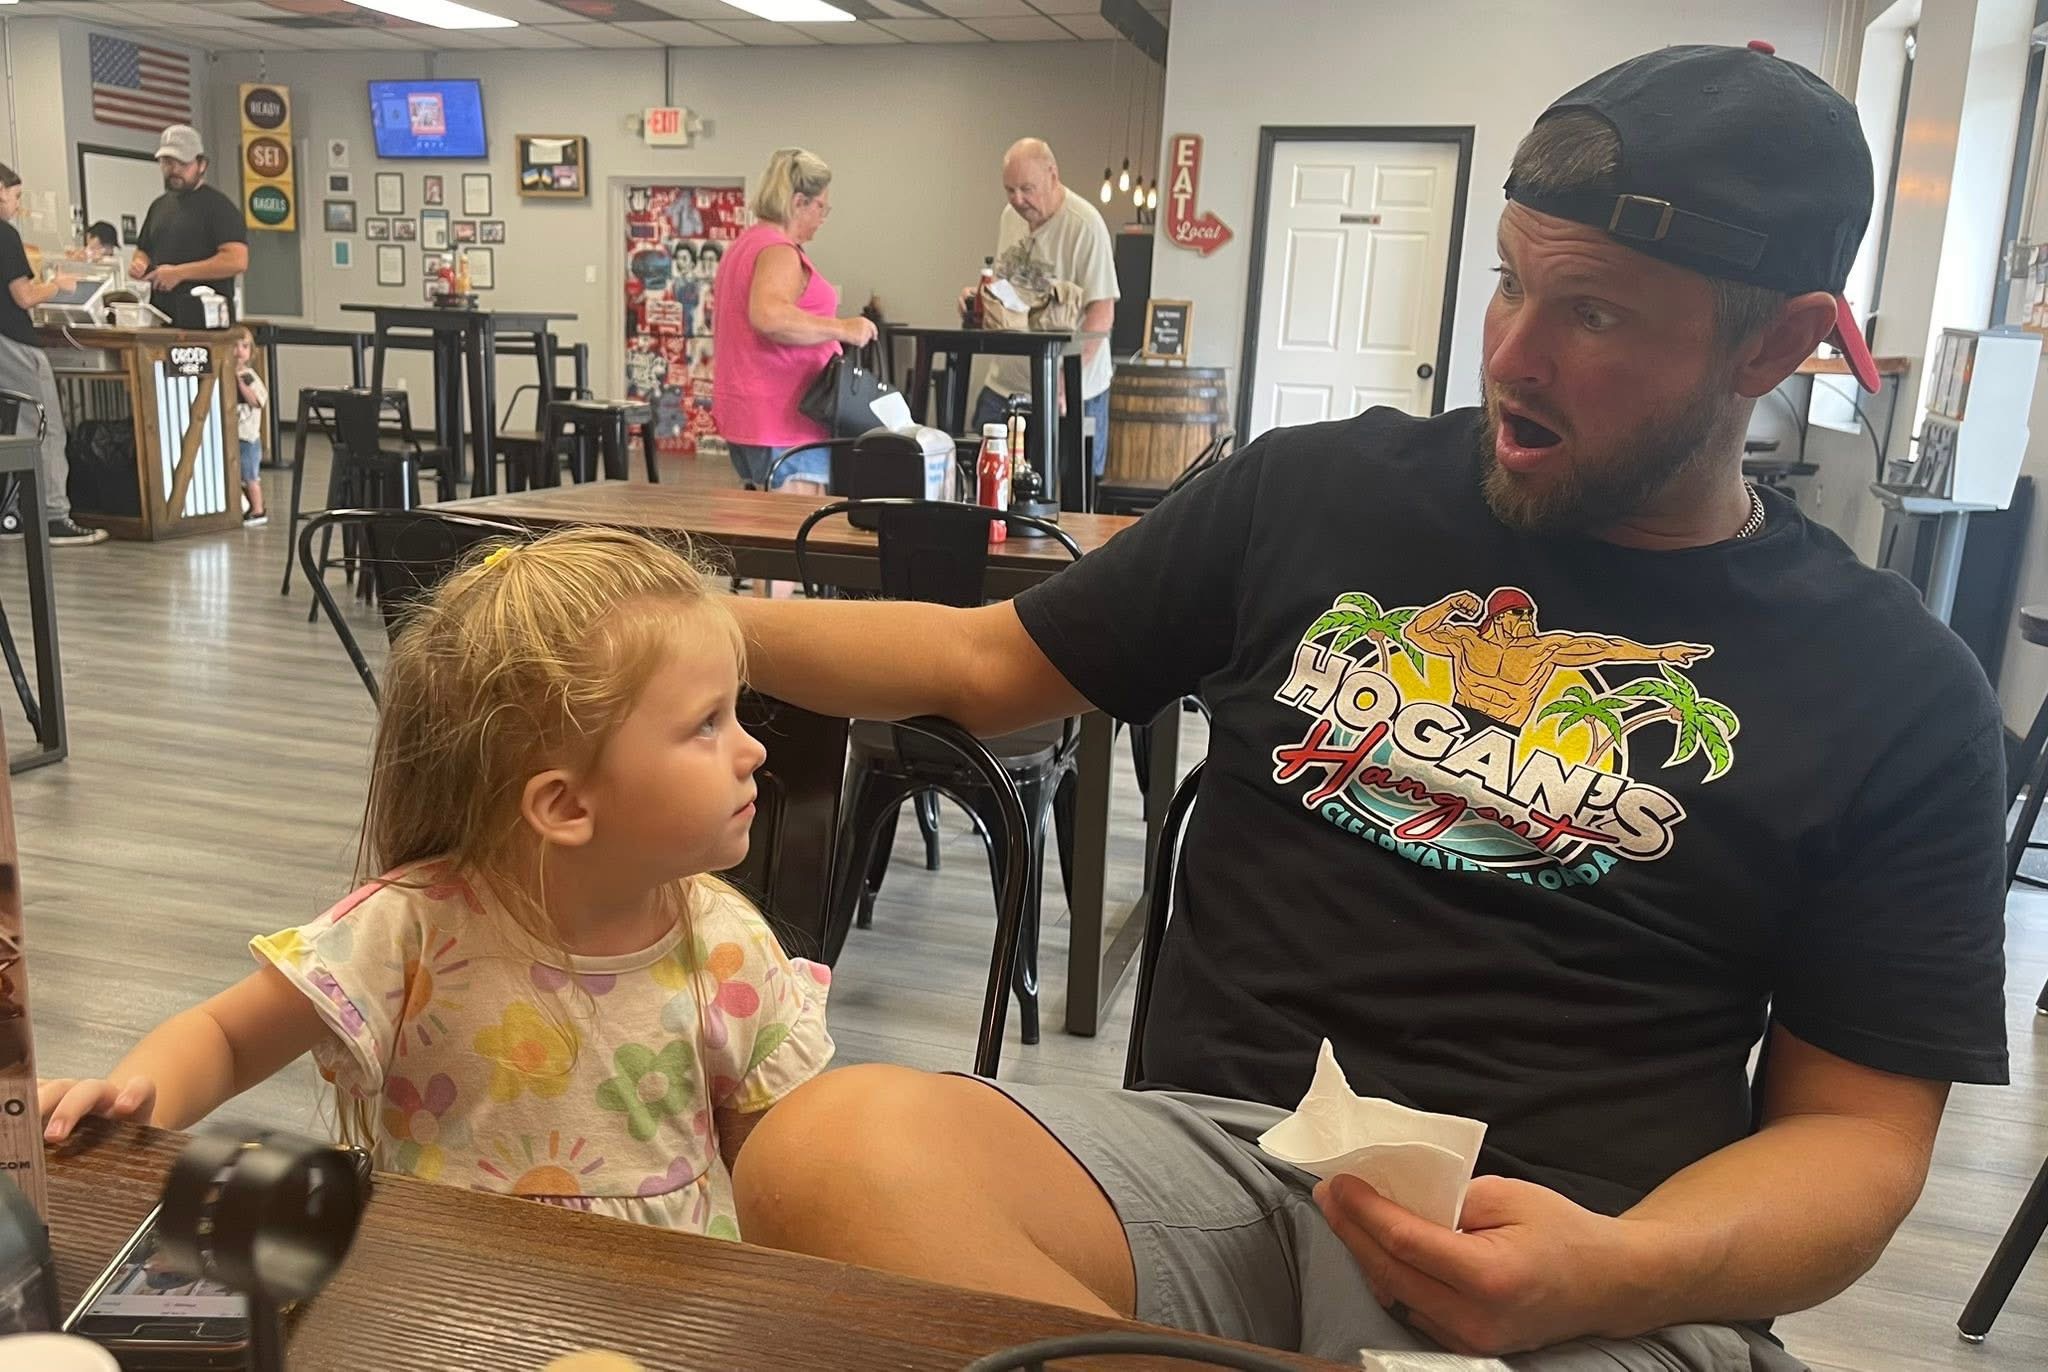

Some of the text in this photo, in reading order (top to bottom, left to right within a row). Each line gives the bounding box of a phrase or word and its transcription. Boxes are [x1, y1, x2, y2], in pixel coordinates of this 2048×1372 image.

[652, 109, 680, 134] EXIT
[254, 145, 281, 167] SET
[1172, 139, 1196, 219] EAT
[1175, 220, 1222, 242] Local
[171, 346, 209, 365] ORDER
[1278, 645, 1684, 858] HOGAN'S
